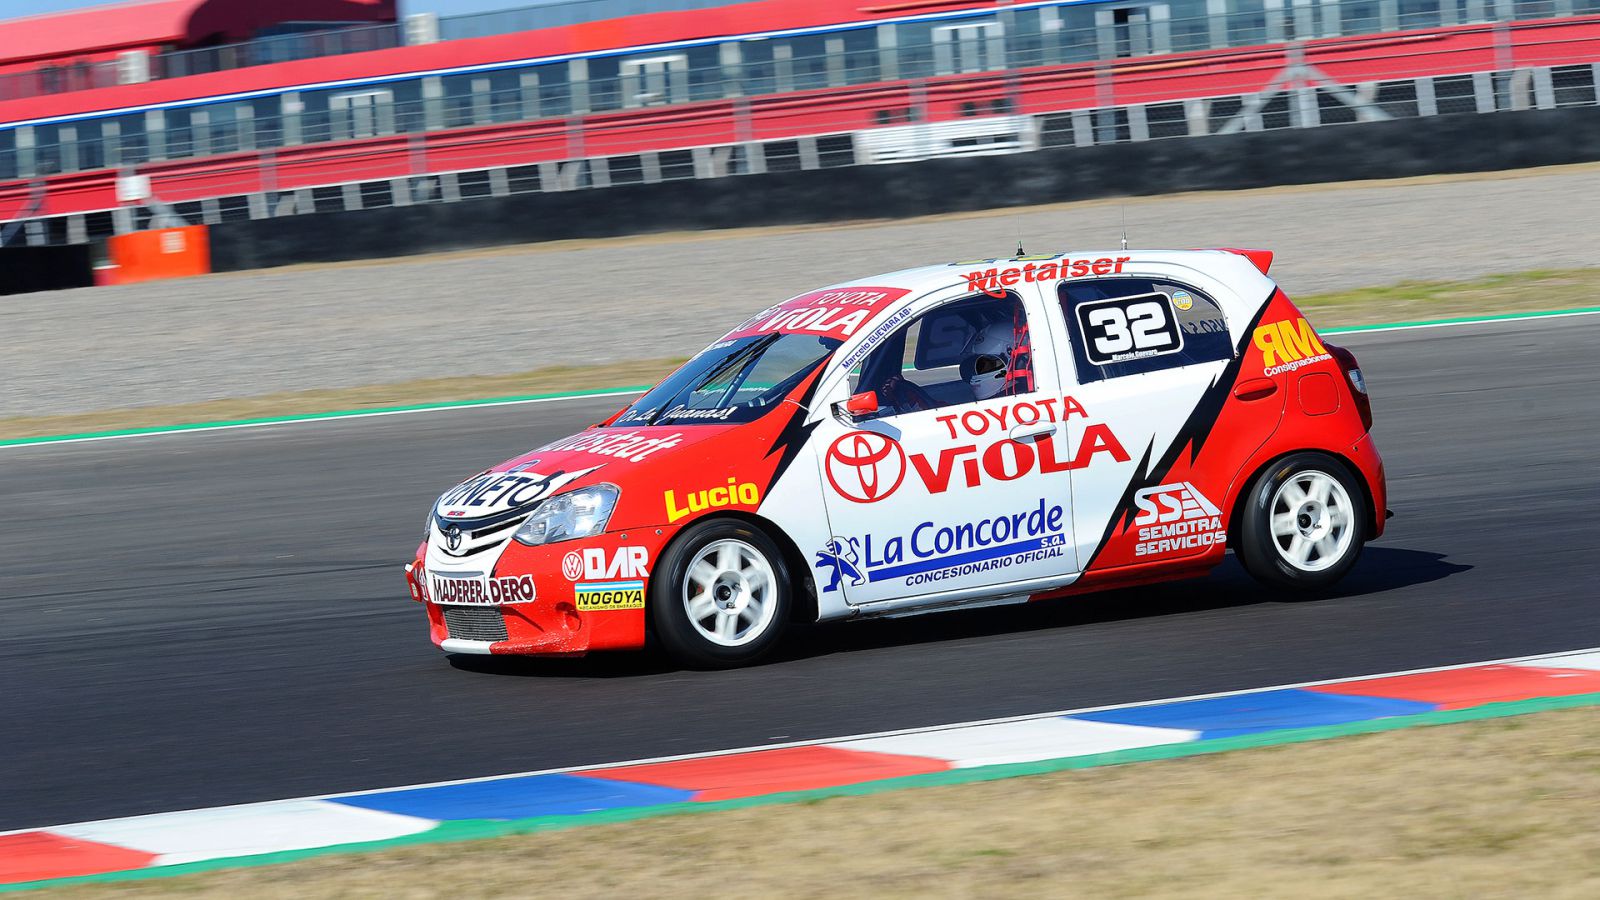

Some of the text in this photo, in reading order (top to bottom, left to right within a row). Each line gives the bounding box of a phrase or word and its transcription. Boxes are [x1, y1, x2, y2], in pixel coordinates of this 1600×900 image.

[963, 256, 1131, 297] Metalser
[809, 291, 888, 307] TOYOTA
[842, 342, 870, 370] Marcelo
[868, 316, 901, 345] GUEVARA
[1088, 301, 1172, 354] 32
[936, 395, 1089, 439] TOYOTA
[664, 476, 759, 523] Lucio
[865, 498, 1064, 568] La Concorde
[1135, 530, 1227, 557] SERVICIOS
[1138, 516, 1223, 541] SEMOTRA
[583, 545, 650, 580] DAR
[905, 546, 1064, 588] CONCESIONARIO OFICIAL
[578, 590, 643, 606] NOGOYA
